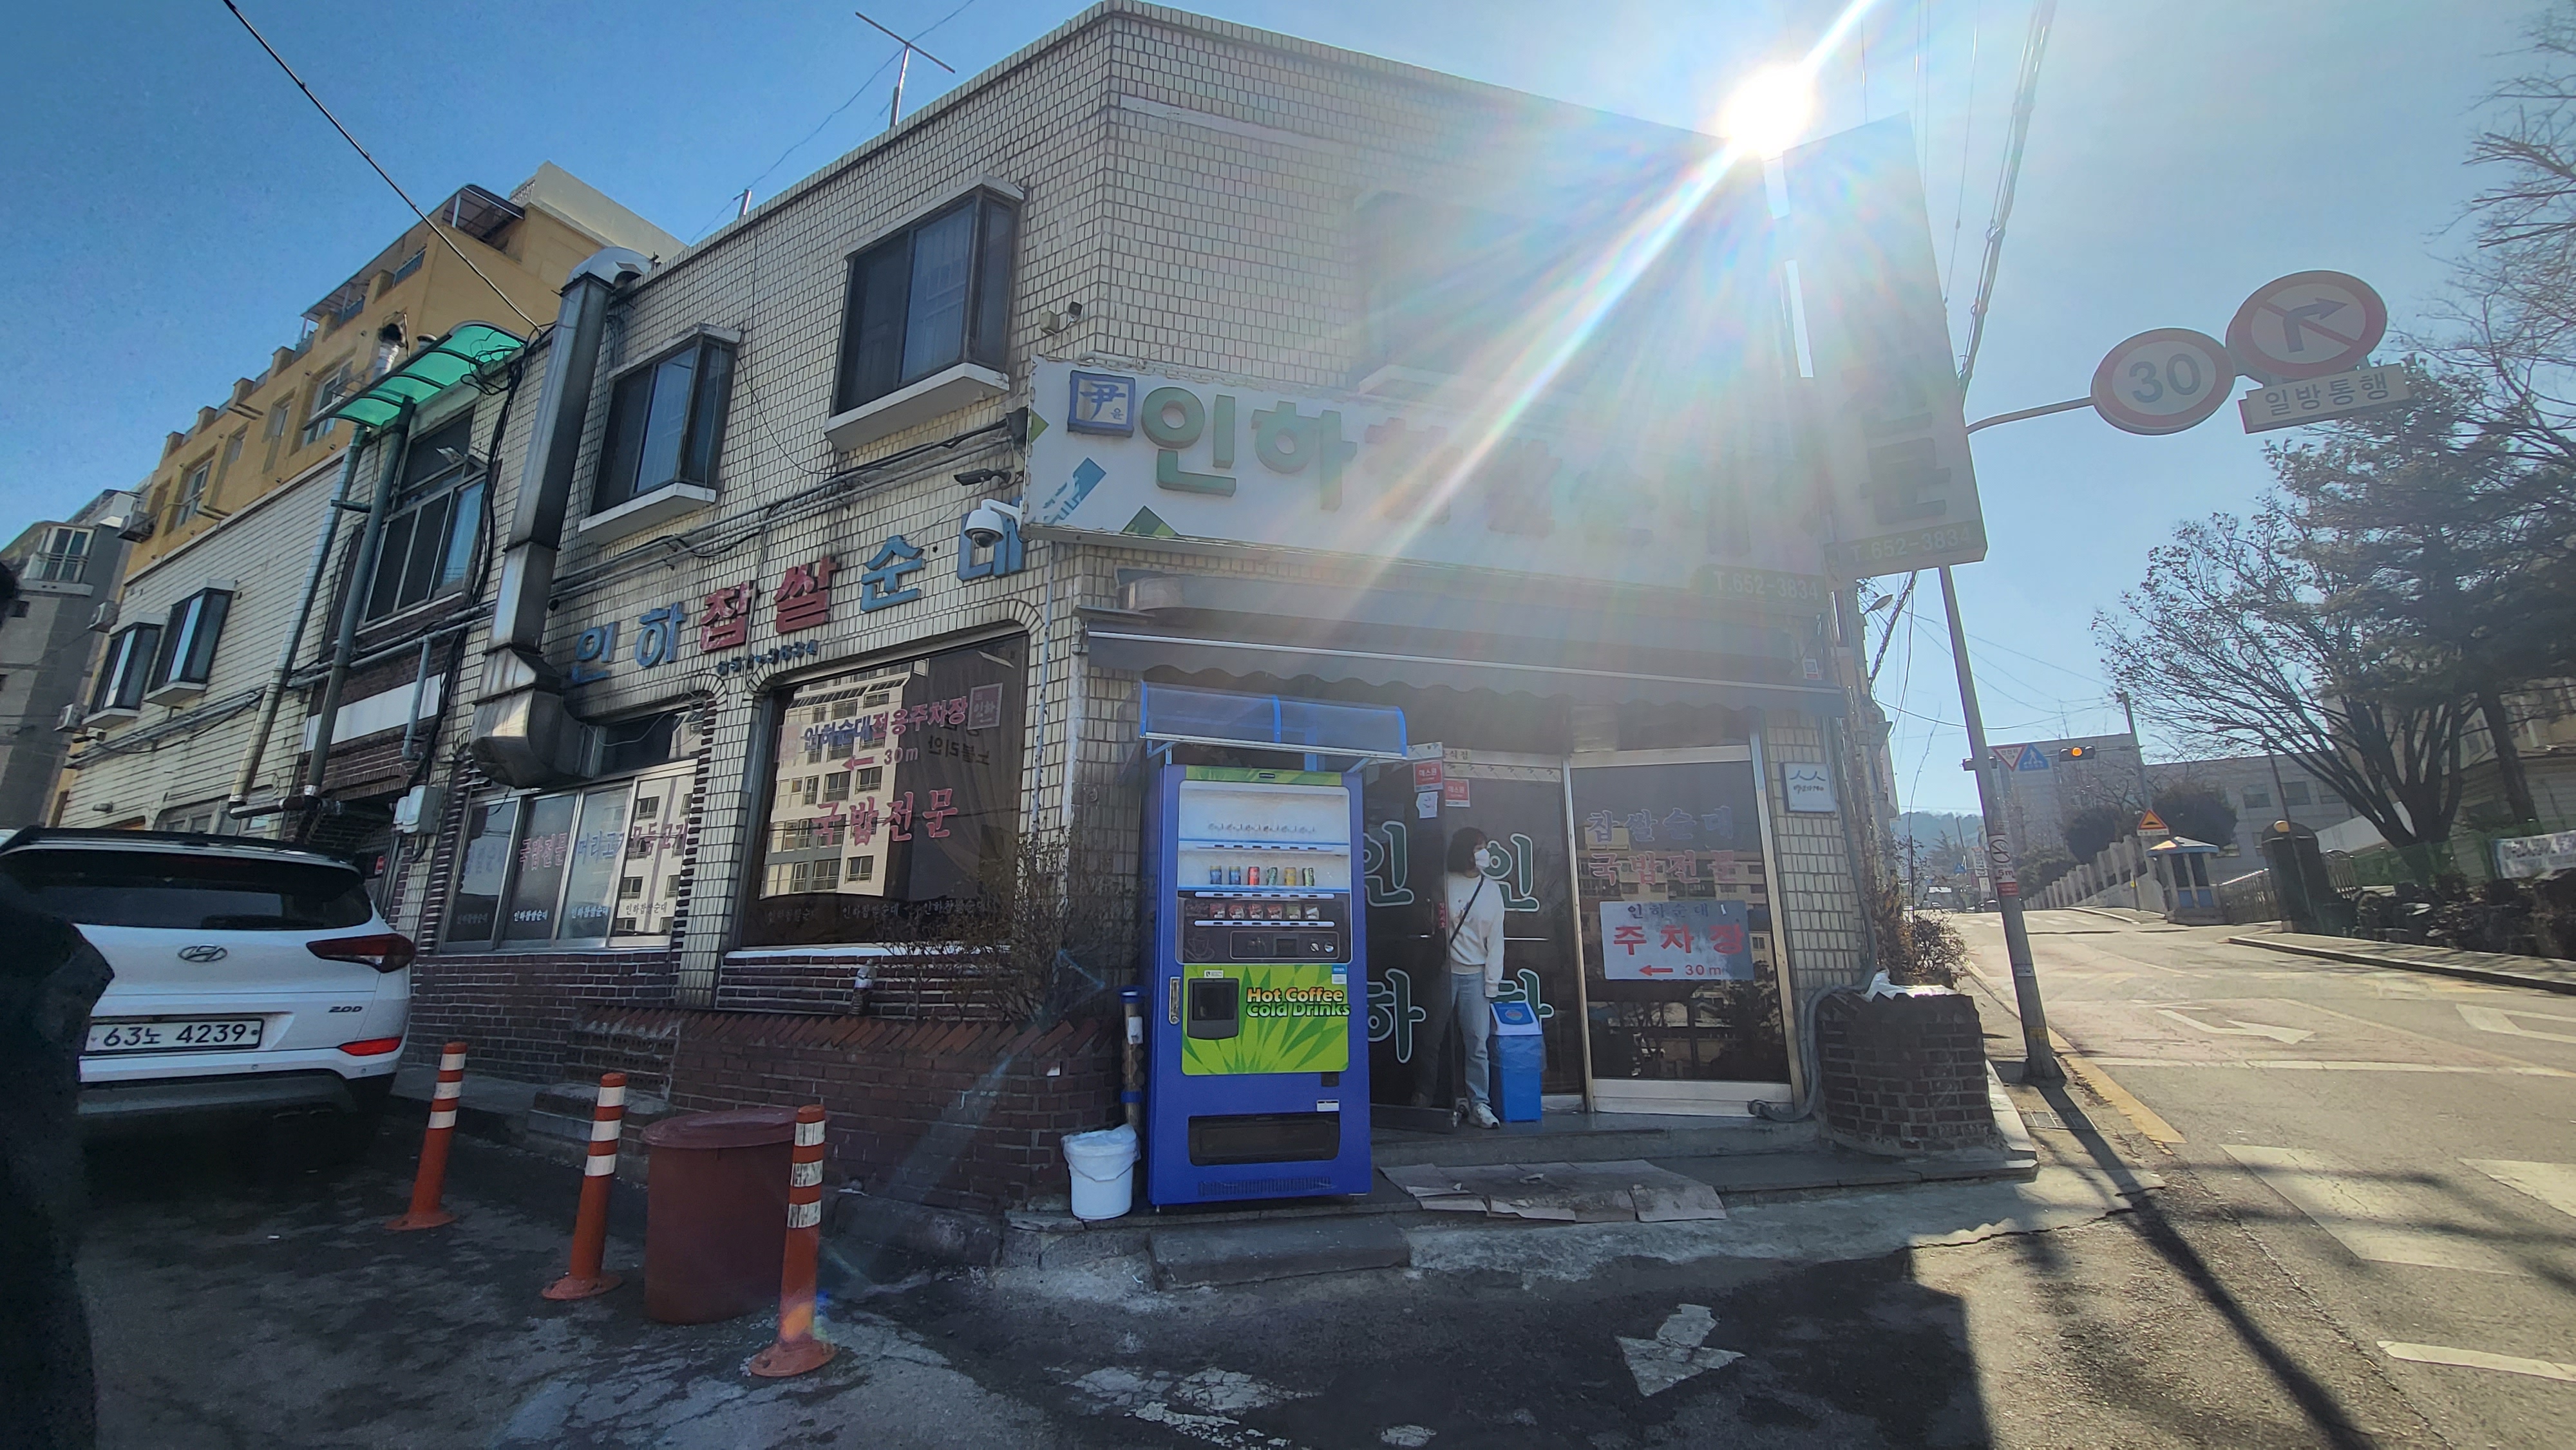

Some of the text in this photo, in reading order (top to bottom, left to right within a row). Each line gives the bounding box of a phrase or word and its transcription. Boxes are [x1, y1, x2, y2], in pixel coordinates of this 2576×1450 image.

[2128, 353, 2202, 404] 30
[2264, 372, 2389, 417] 일방통행
[1849, 525, 1972, 564] T.652-3834
[1713, 569, 1820, 603] T.652-3834
[811, 788, 958, 847] 국밥전문
[1586, 805, 1734, 843] 찹쌀순대
[518, 832, 568, 872] 국밥전문
[1587, 849, 1739, 886] 국밥전문
[1627, 903, 1709, 920] 인하순대
[1613, 925, 1745, 956] 주차장
[1246, 986, 1343, 1003] Hot Coffee
[1246, 1002, 1350, 1017] Cold Drinks
[103, 1024, 247, 1046] 63노 4239
